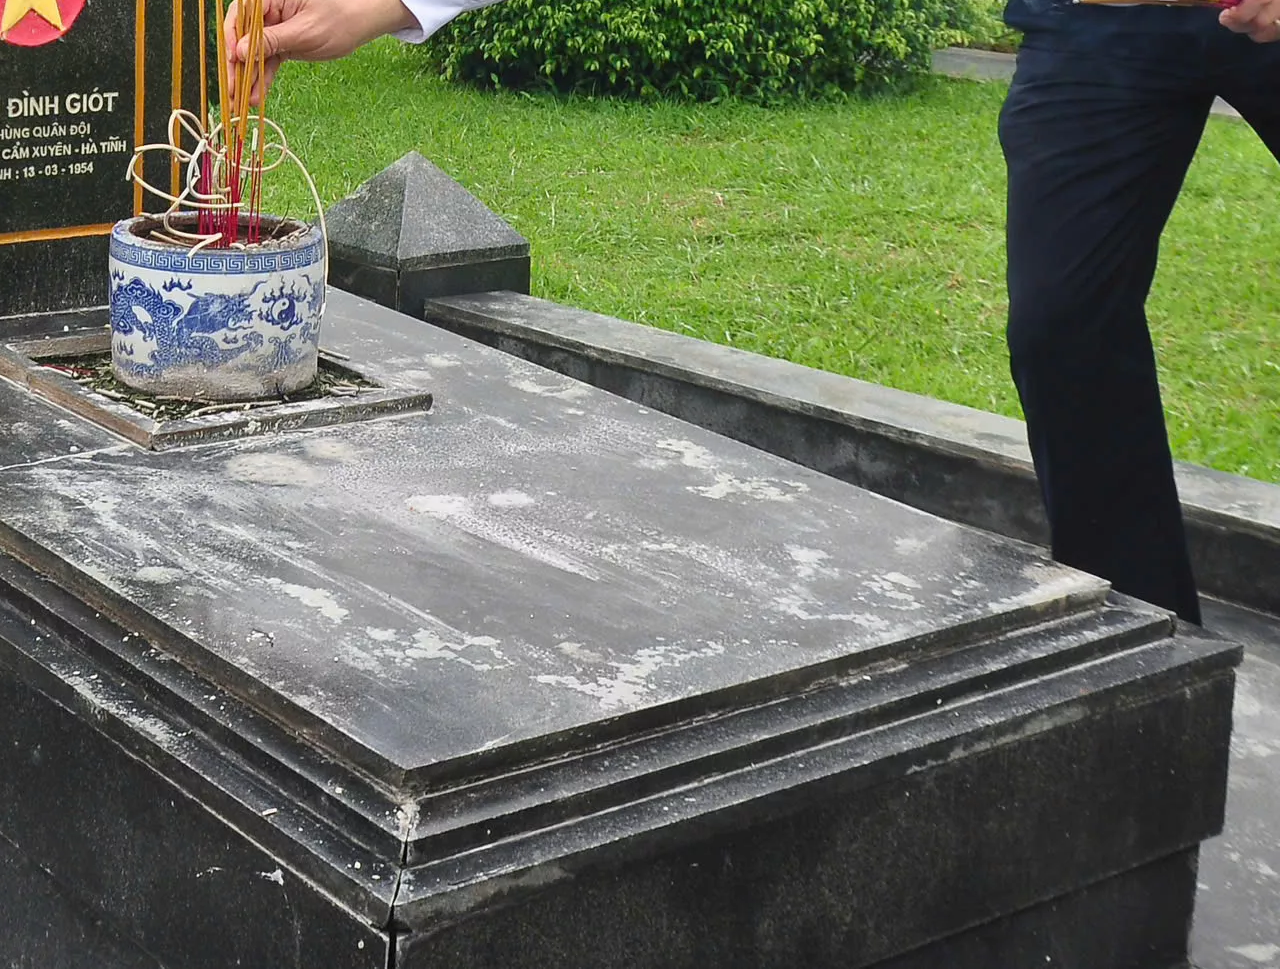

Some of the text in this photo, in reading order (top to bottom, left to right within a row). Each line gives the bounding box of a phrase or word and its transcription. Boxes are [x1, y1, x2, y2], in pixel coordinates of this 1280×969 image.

[7, 90, 59, 118] ĐÌNH
[66, 87, 118, 114] GIÓT
[33, 123, 66, 137] QUÂN
[70, 121, 90, 139] ĐỘI
[32, 142, 71, 158] XUYÊN
[81, 138, 98, 155] HÀ
[100, 136, 126, 153] TĨNH
[23, 166, 35, 177] 13
[45, 164, 57, 176] 03
[69, 162, 93, 175] 1954
